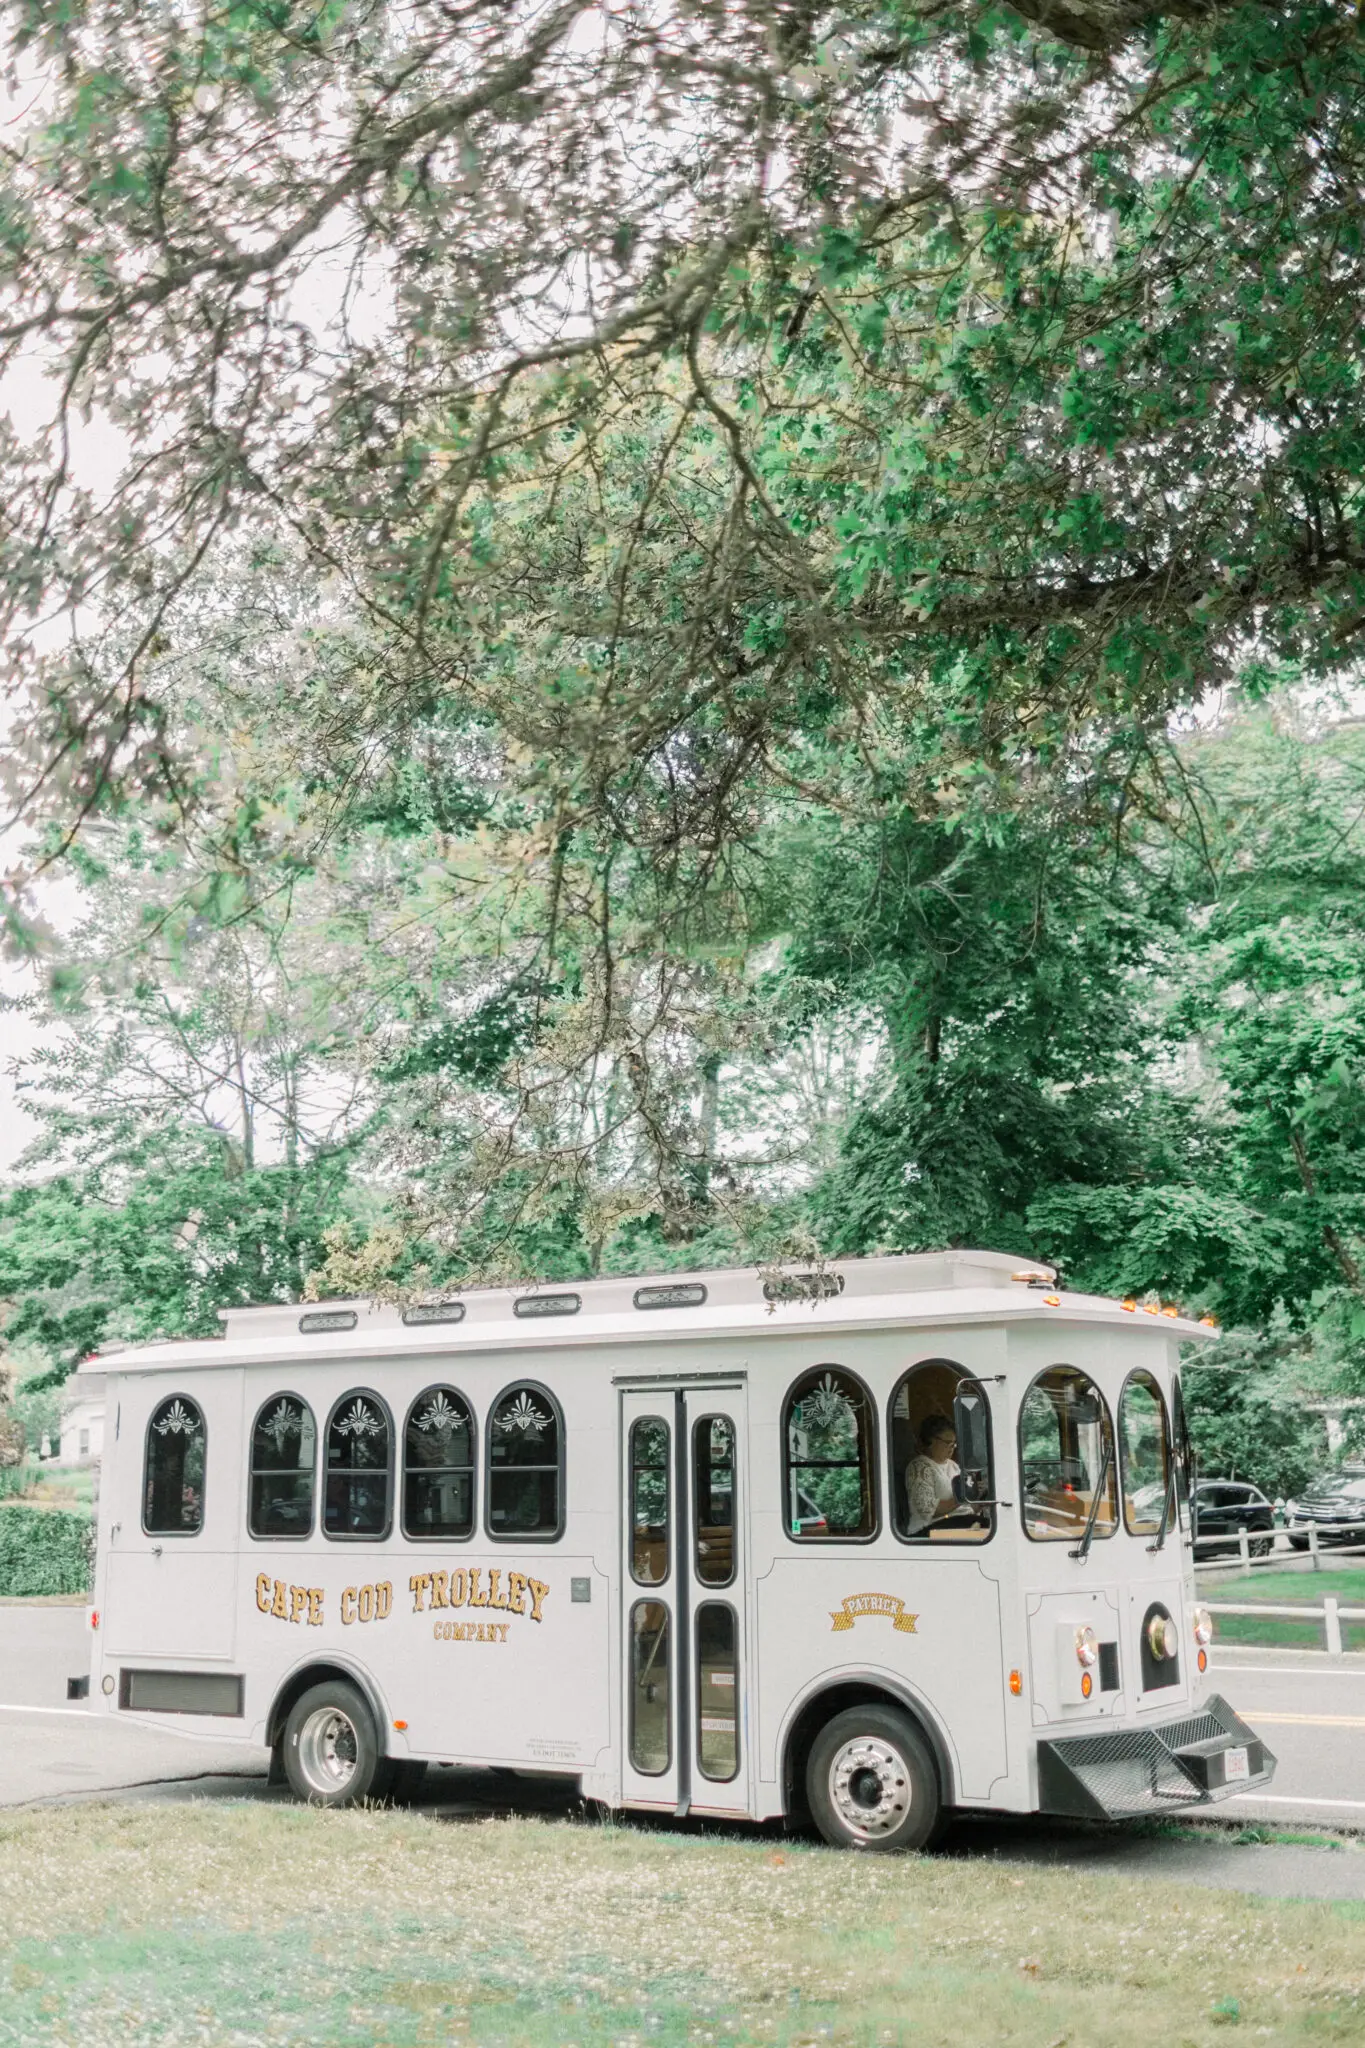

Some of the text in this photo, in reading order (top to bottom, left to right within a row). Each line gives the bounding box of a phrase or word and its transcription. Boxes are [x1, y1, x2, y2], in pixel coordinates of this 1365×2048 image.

[256, 1568, 549, 1626] CAPE COD TROLLEY
[846, 1596, 899, 1614] PATRICK
[433, 1621, 511, 1642] COMPANY
